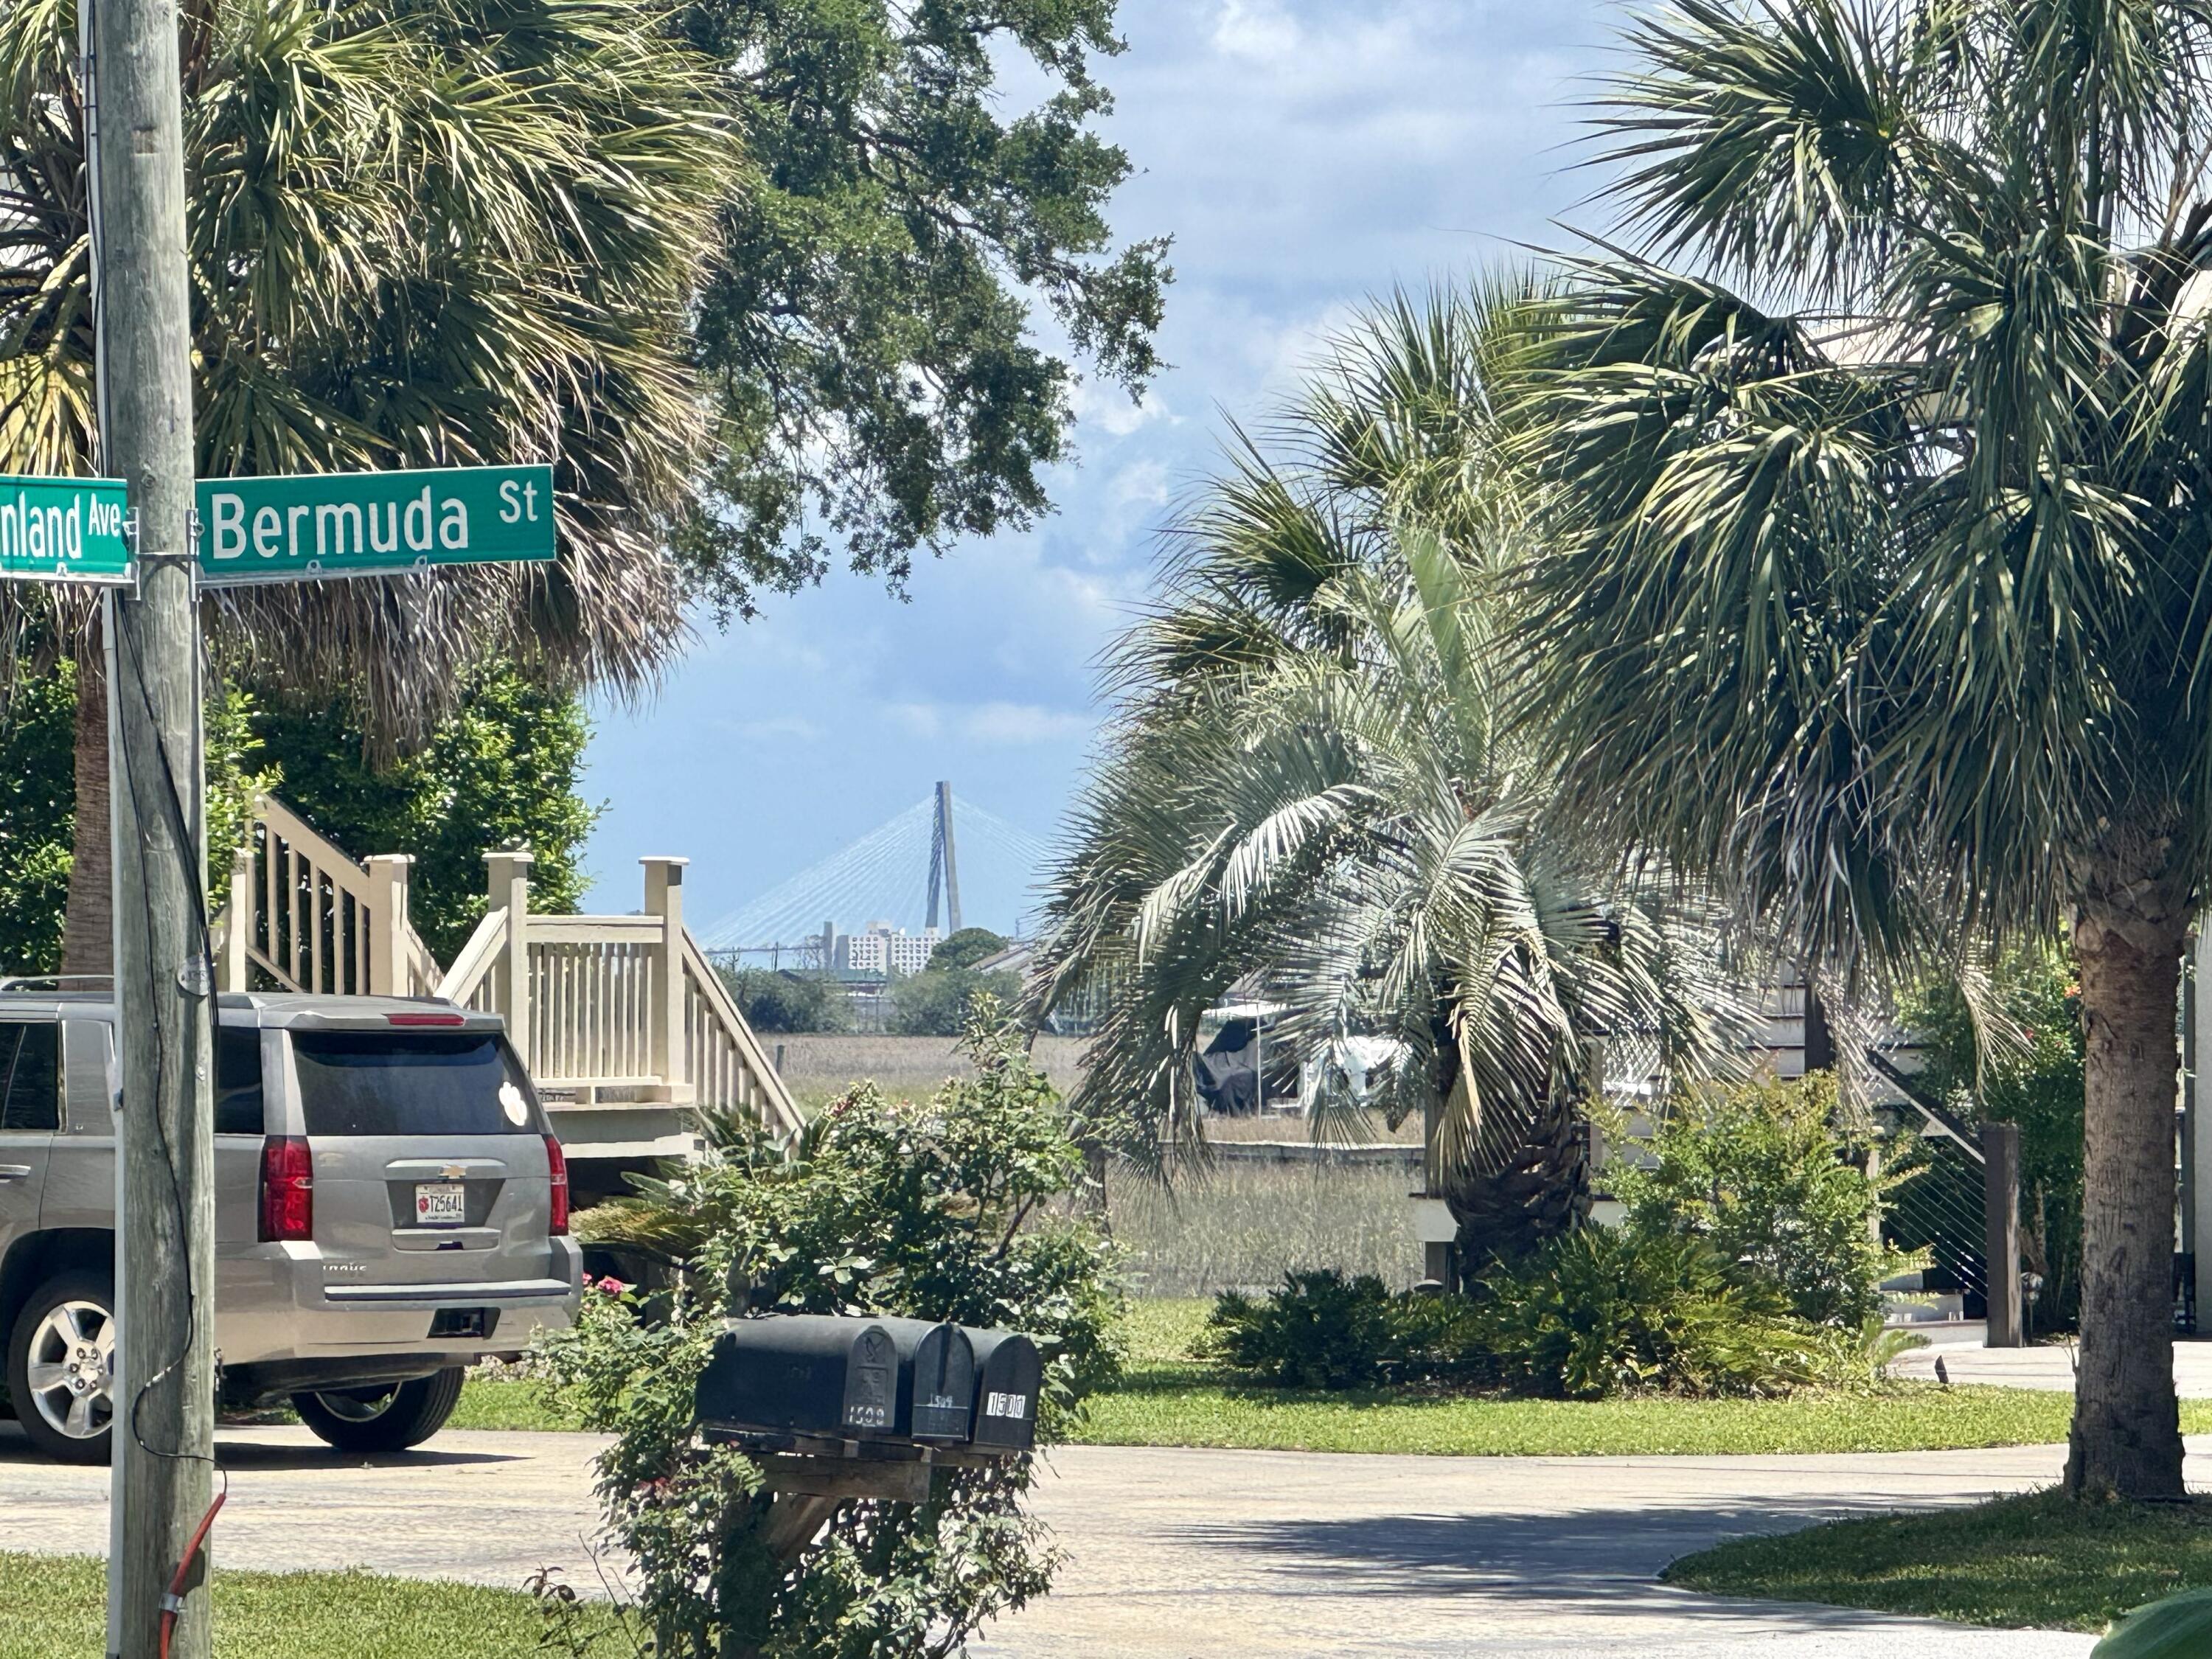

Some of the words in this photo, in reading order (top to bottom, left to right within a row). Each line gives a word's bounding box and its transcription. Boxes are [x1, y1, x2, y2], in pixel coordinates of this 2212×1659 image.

[88, 493, 121, 538] Ave
[212, 484, 469, 560] Bermuda
[498, 479, 538, 524] St
